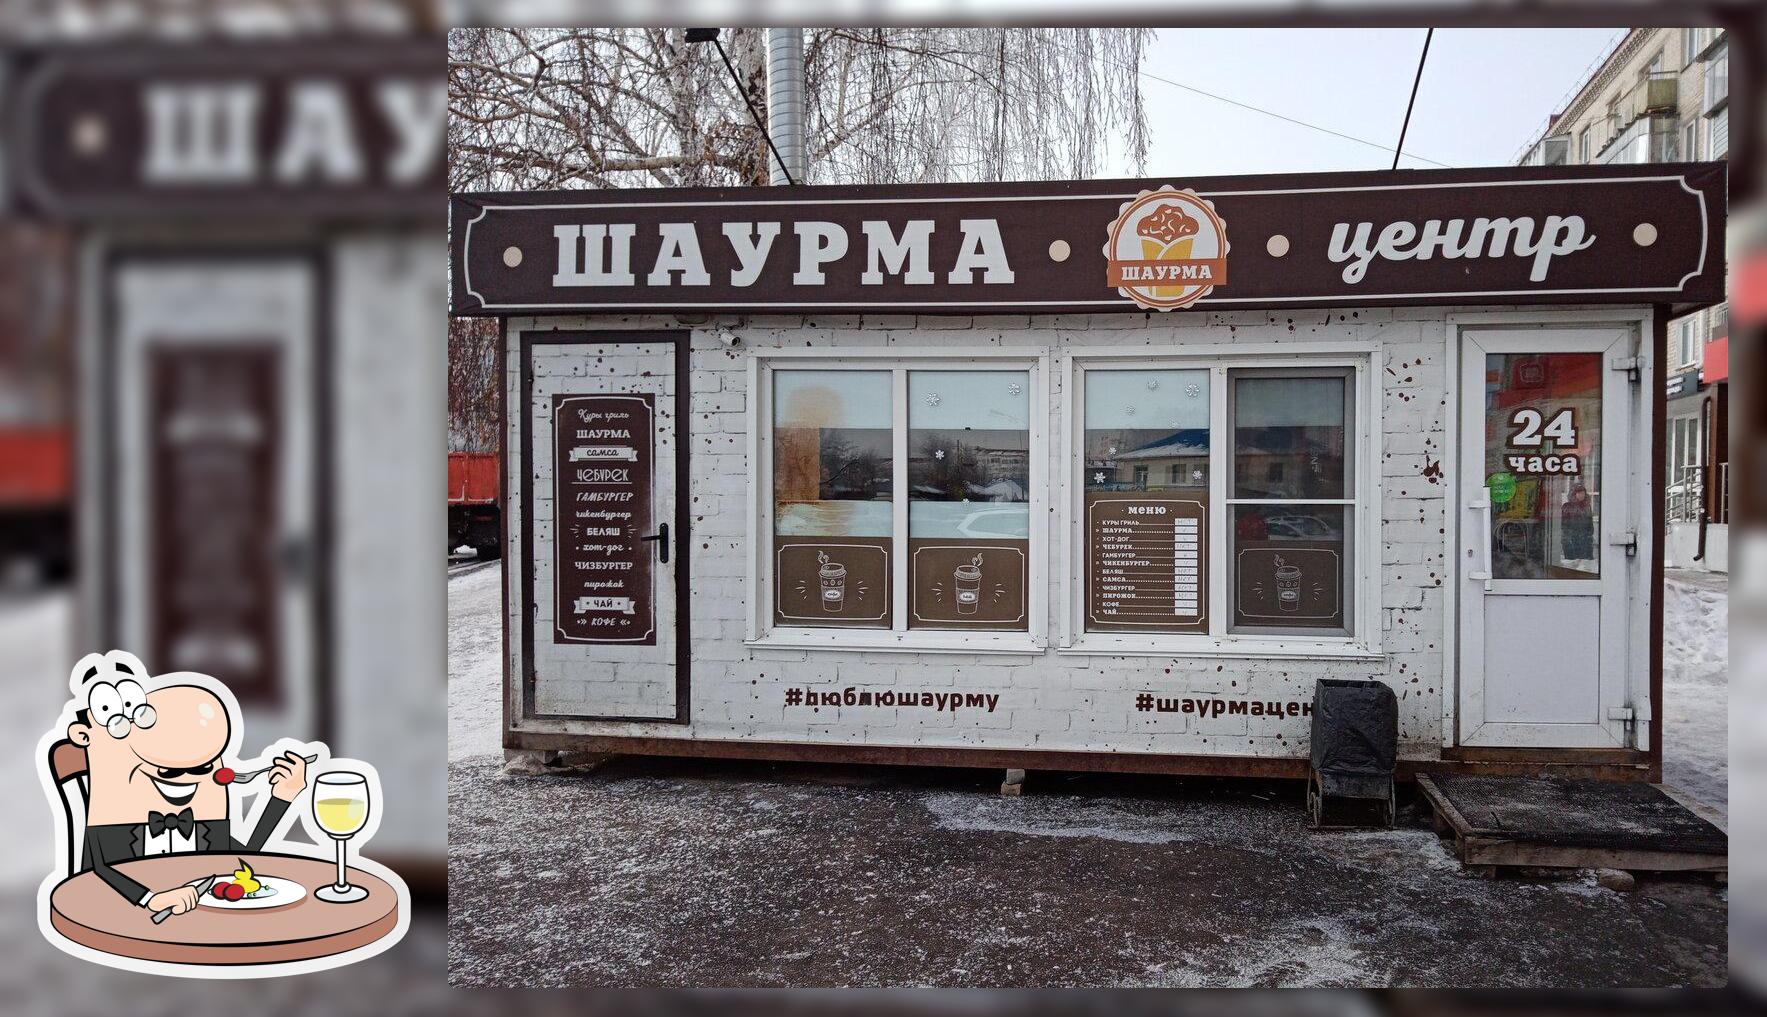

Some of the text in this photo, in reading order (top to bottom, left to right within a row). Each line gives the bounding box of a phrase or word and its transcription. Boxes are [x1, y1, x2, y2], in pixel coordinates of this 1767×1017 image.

[552, 215, 1597, 287] ШАУРМА центр
[1121, 264, 1213, 281] ШАУРМА
[577, 408, 603, 423] Куры
[1510, 408, 1577, 447] 24
[576, 429, 631, 439] ШАУРМА
[586, 448, 620, 457] самса
[1507, 455, 1579, 474] часа
[576, 491, 634, 502] ГАМБУРГЕР
[575, 509, 632, 521] чикенбургер
[1128, 505, 1167, 515] меню
[586, 527, 621, 537] БЕЛЯШ
[582, 543, 625, 556] хот-дог
[574, 561, 634, 571] ЧИЗБУРГЕР
[583, 579, 625, 591] пирожок
[593, 598, 613, 608] ЧАЙ
[591, 617, 617, 627] КОФЕ
